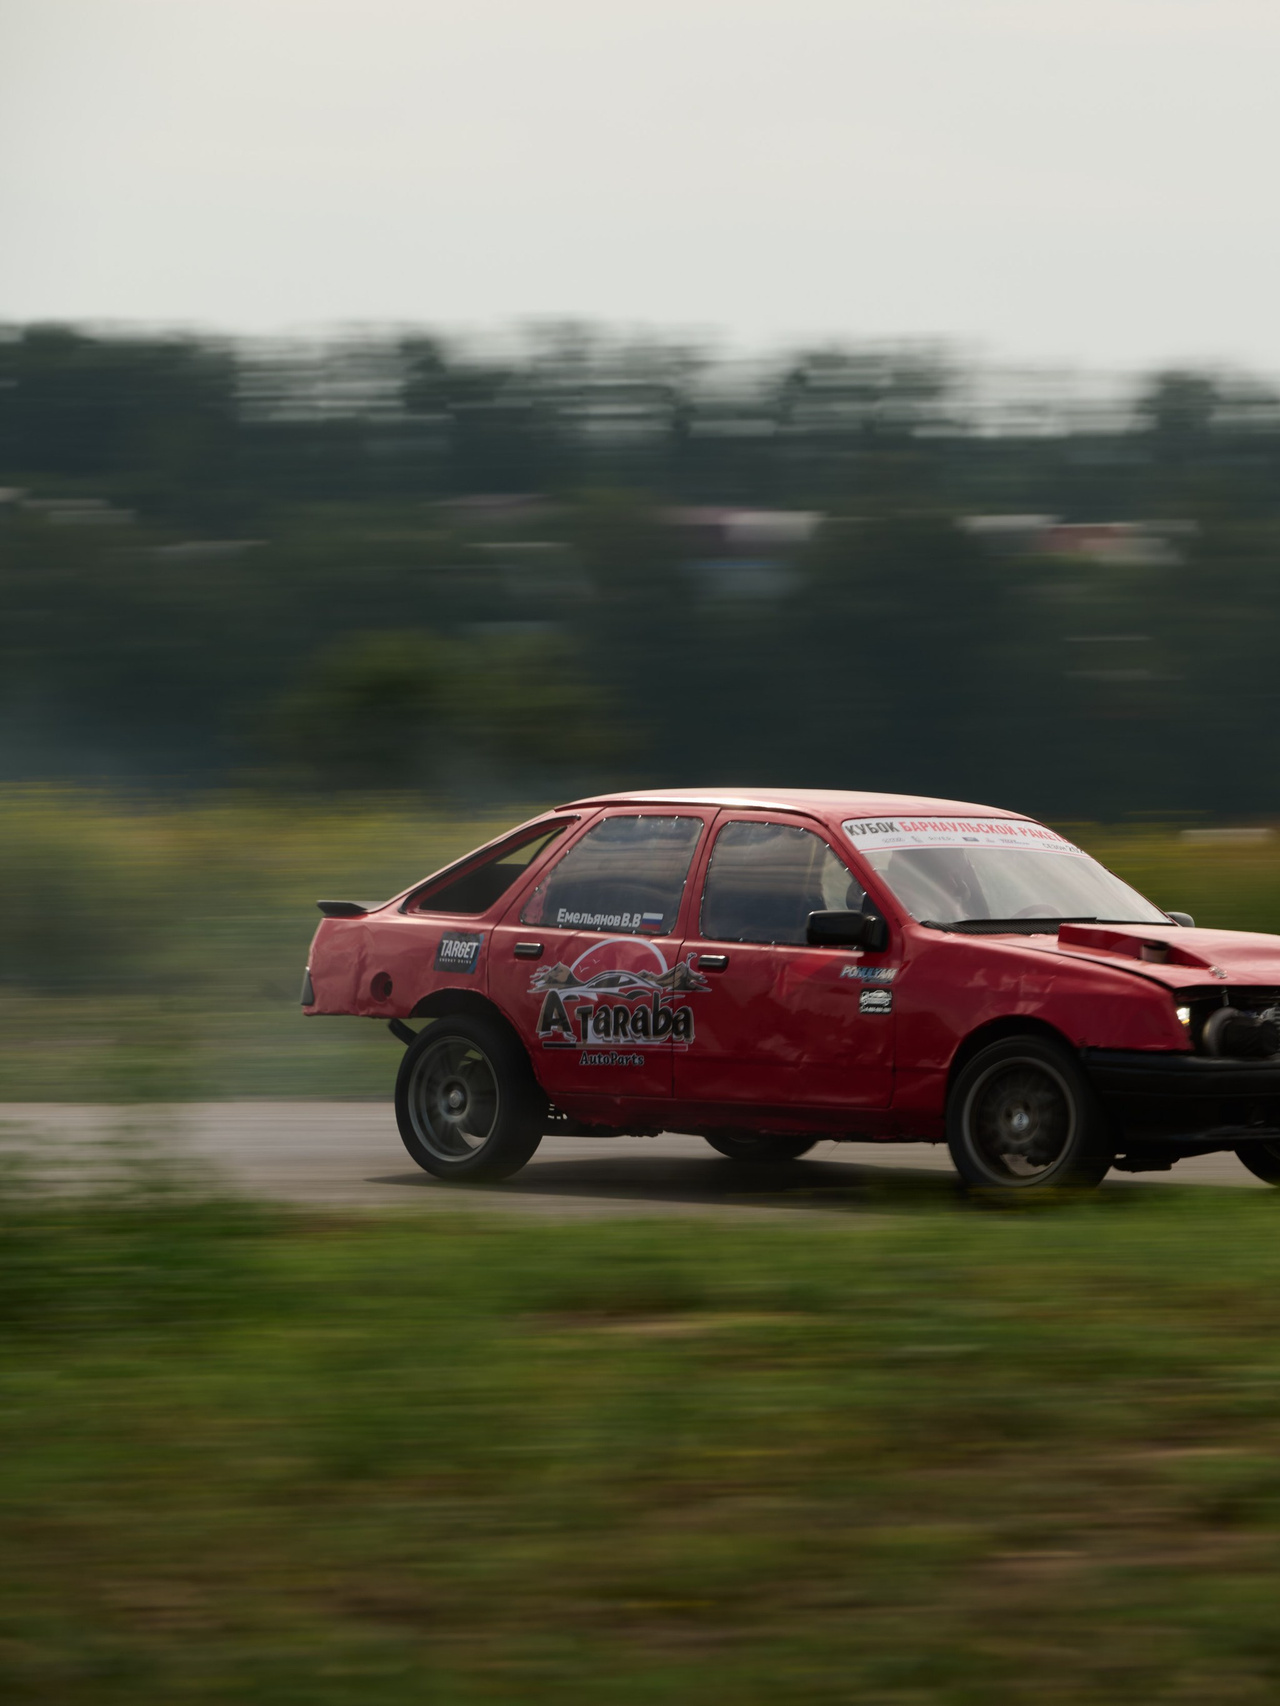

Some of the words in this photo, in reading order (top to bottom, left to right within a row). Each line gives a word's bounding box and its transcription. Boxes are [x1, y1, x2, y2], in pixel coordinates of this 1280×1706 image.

[844, 821, 900, 837] КУБОК
[898, 821, 1018, 836] БАРНАУЛЬСКОЙ
[556, 908, 621, 926] Емельянов
[440, 939, 479, 959] TARGET
[579, 1051, 645, 1066] AutoParts
